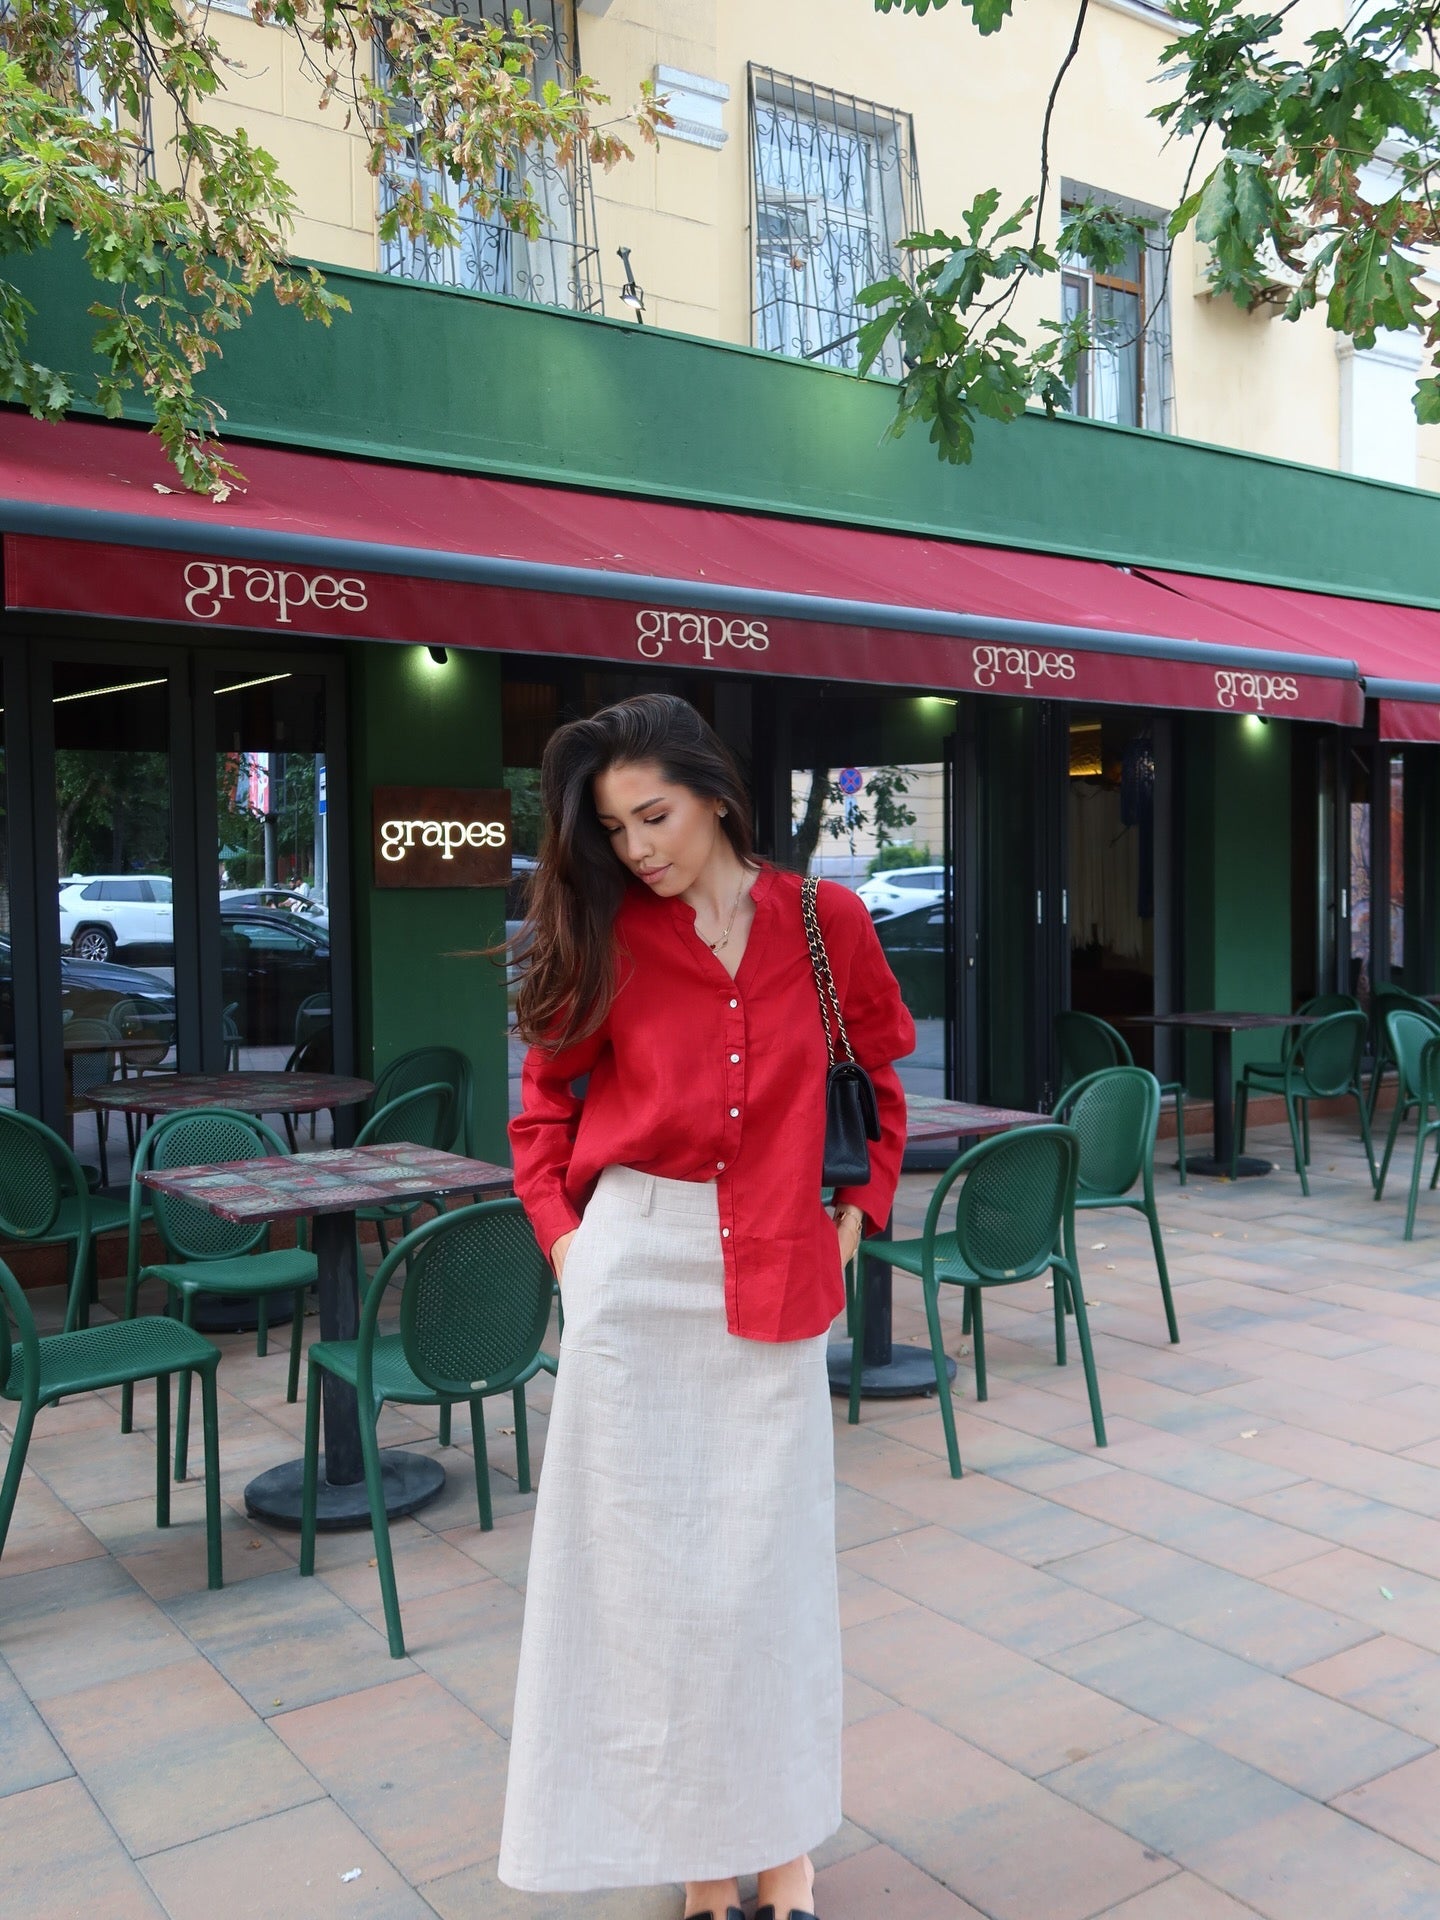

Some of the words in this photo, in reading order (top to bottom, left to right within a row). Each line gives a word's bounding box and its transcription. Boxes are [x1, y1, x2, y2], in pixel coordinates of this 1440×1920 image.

[184, 562, 368, 623] grapes
[636, 610, 769, 660] grapes
[972, 645, 1076, 689] grapes
[1214, 671, 1299, 710] grapes
[381, 820, 506, 862] grapes
